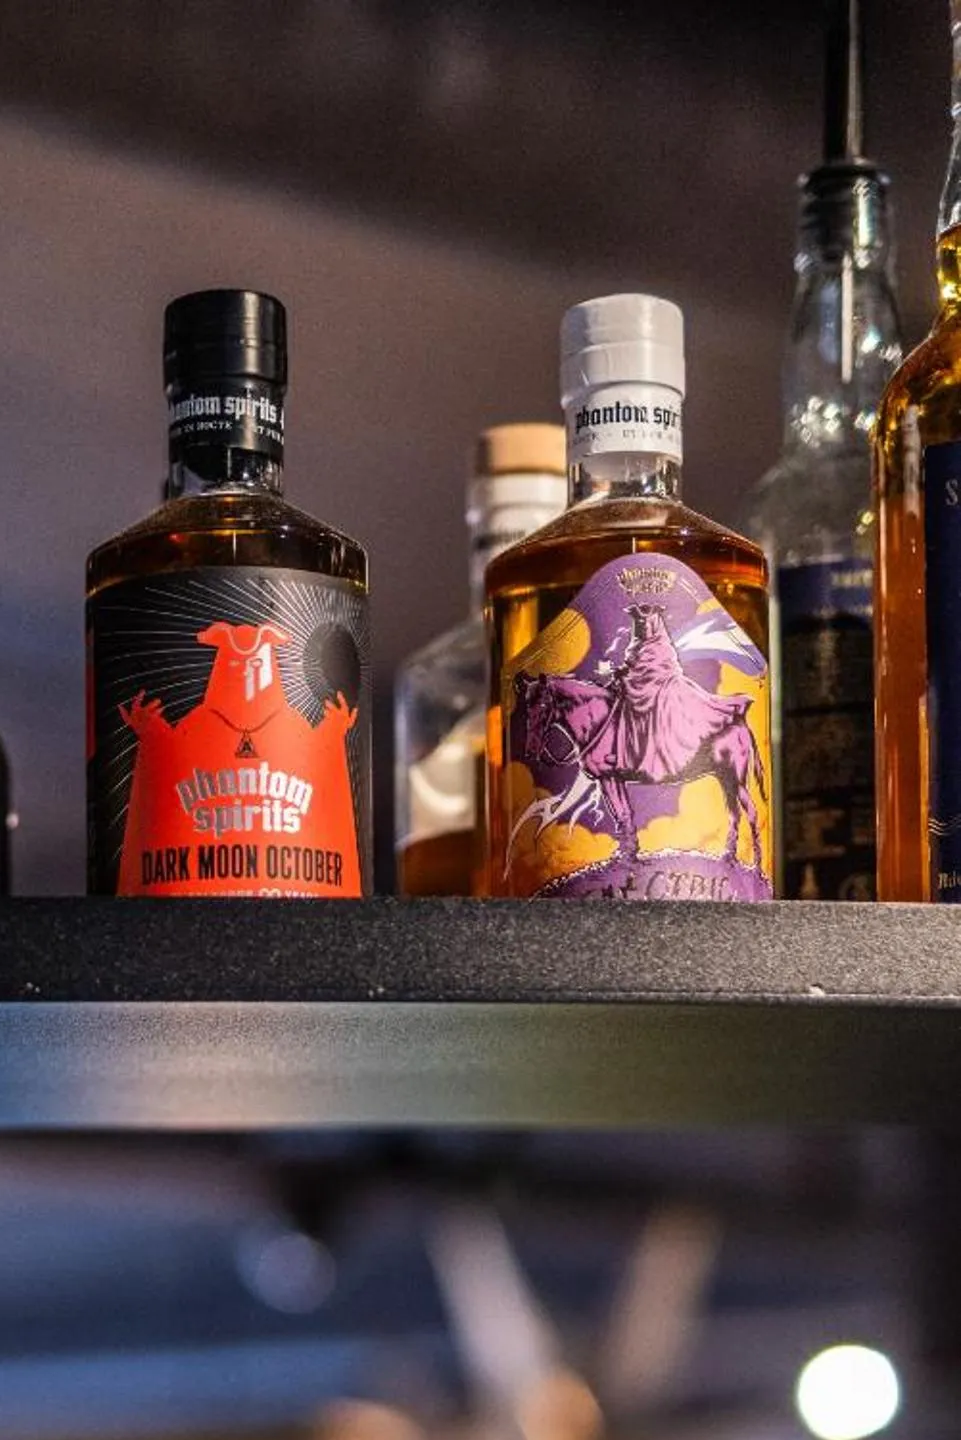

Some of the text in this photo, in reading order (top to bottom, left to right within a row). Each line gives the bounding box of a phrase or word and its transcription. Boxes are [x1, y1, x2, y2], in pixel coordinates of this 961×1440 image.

[224, 395, 277, 423] spirits
[575, 401, 648, 434] phantom
[175, 761, 314, 816] phantom
[193, 799, 302, 840] spirits
[141, 844, 344, 886] DARK MOON OCTOBER
